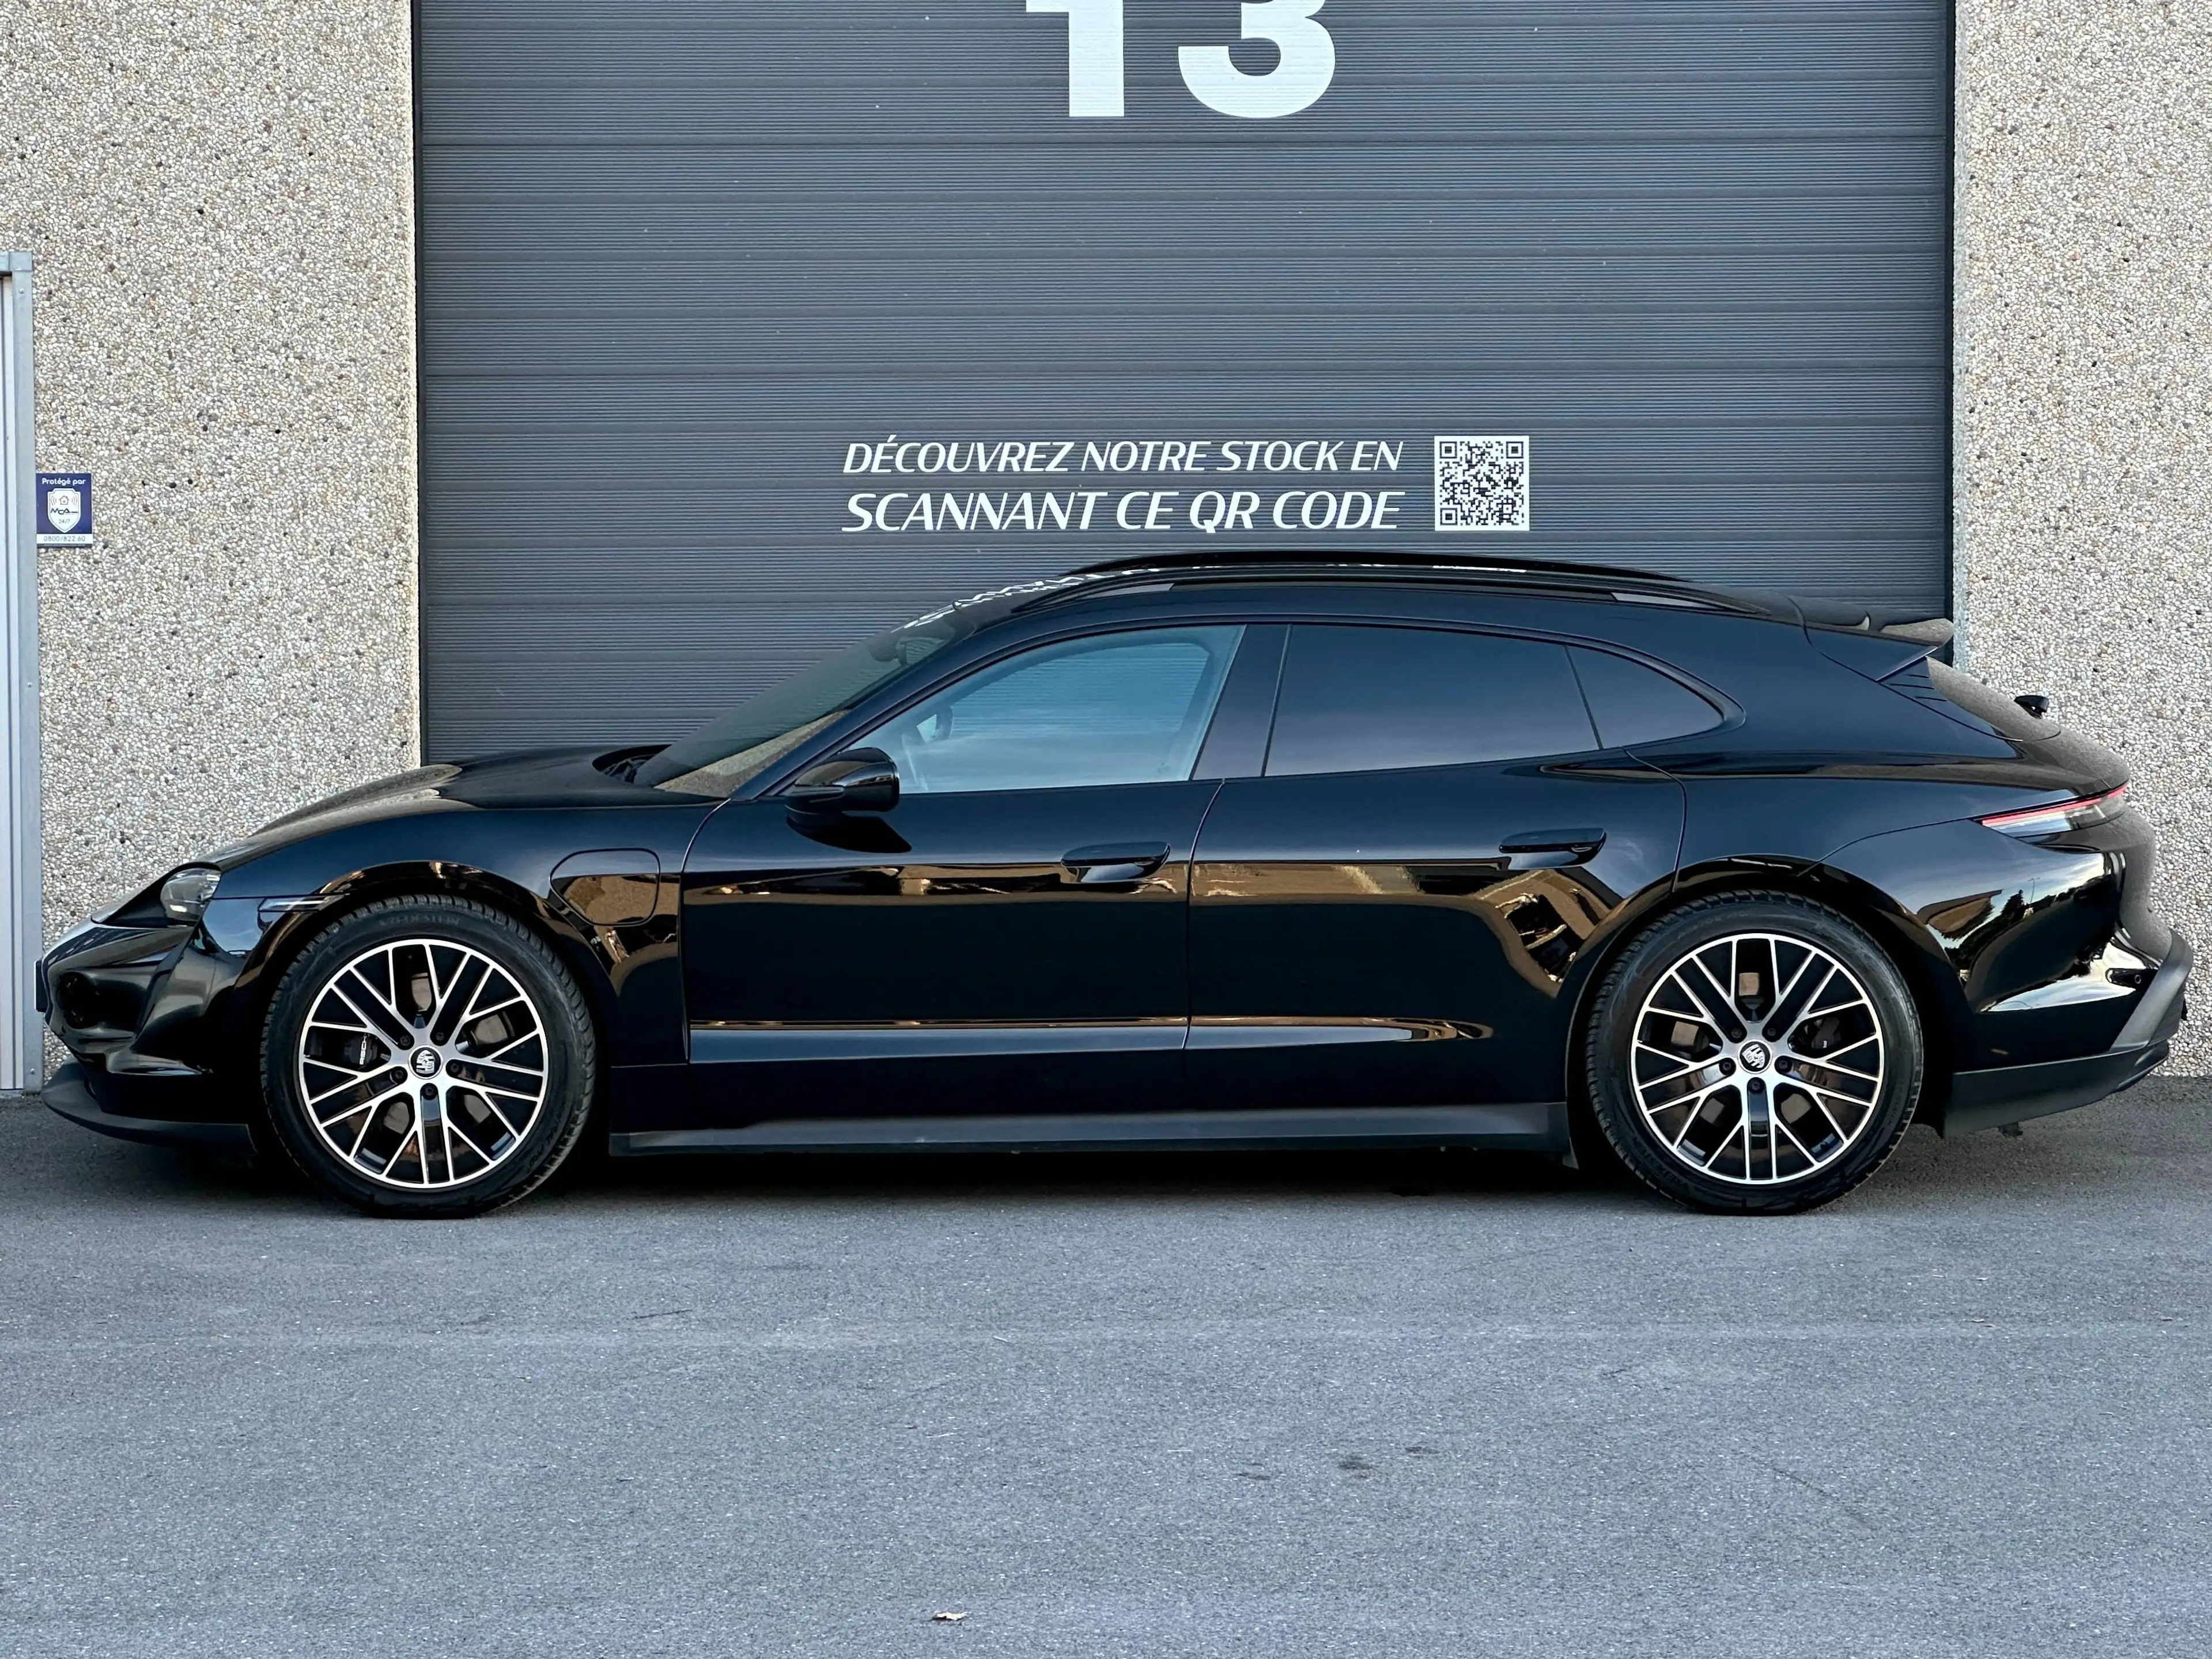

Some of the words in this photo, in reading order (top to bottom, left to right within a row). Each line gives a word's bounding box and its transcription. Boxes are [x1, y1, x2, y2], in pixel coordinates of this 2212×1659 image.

[1026, 0, 1335, 118] 13
[843, 435, 1075, 473] DÉCOUVREZ
[1081, 441, 1211, 471] NOTRE
[1216, 441, 1344, 471] STOCK
[1351, 441, 1404, 471] EN
[42, 478, 70, 486] Protégé
[841, 491, 1108, 532] SCANNANT
[1117, 491, 1179, 529] CE
[1189, 491, 1260, 533] QR
[1273, 491, 1405, 529] CODE
